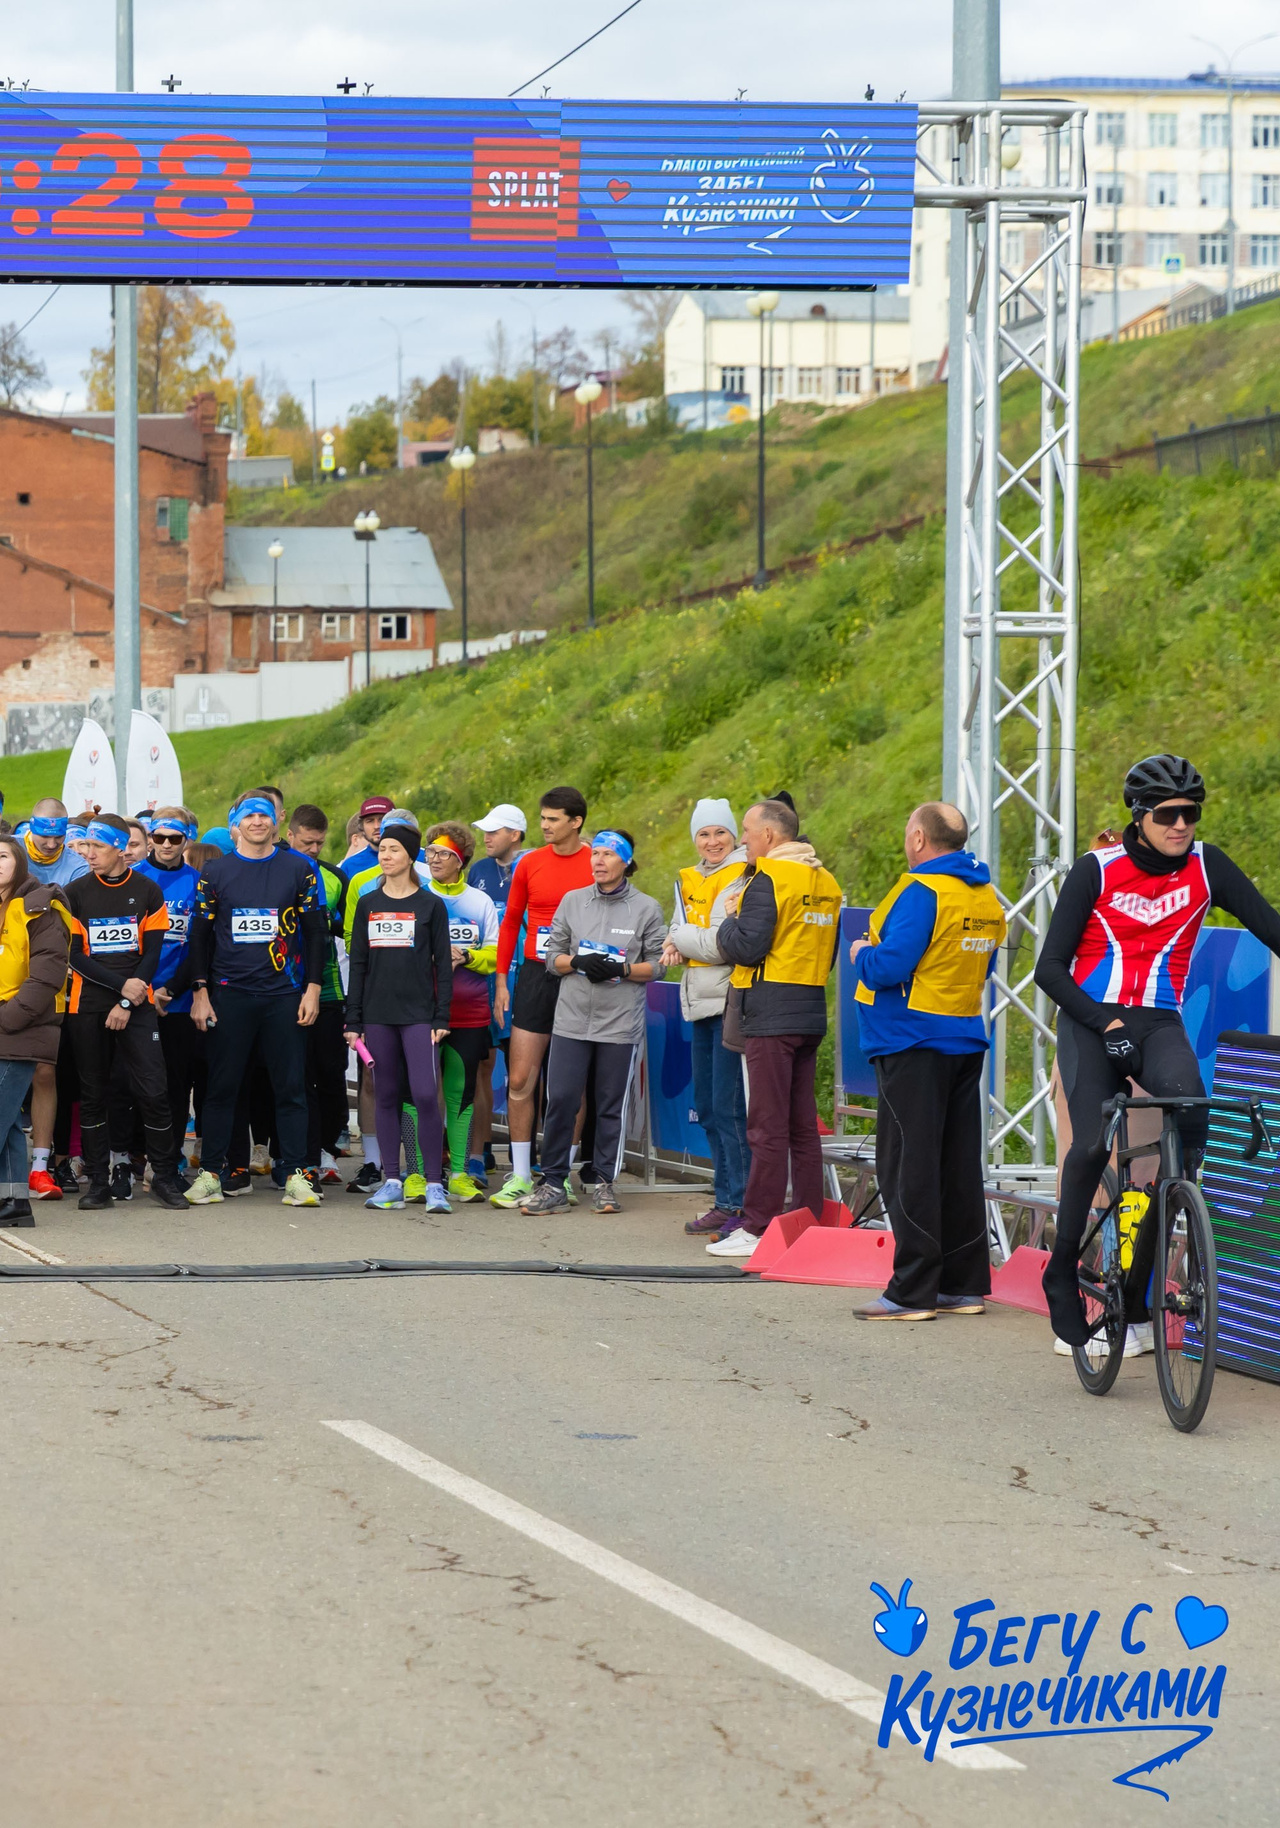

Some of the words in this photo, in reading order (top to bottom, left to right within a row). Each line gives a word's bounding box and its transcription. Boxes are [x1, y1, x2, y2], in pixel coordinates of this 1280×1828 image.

[487, 171, 564, 208] SPLAT
[1108, 885, 1191, 927] RUSSIA
[238, 920, 272, 931] 435
[376, 922, 403, 933] 193
[96, 928, 132, 941] 429
[961, 936, 997, 954] СУДЬЯ
